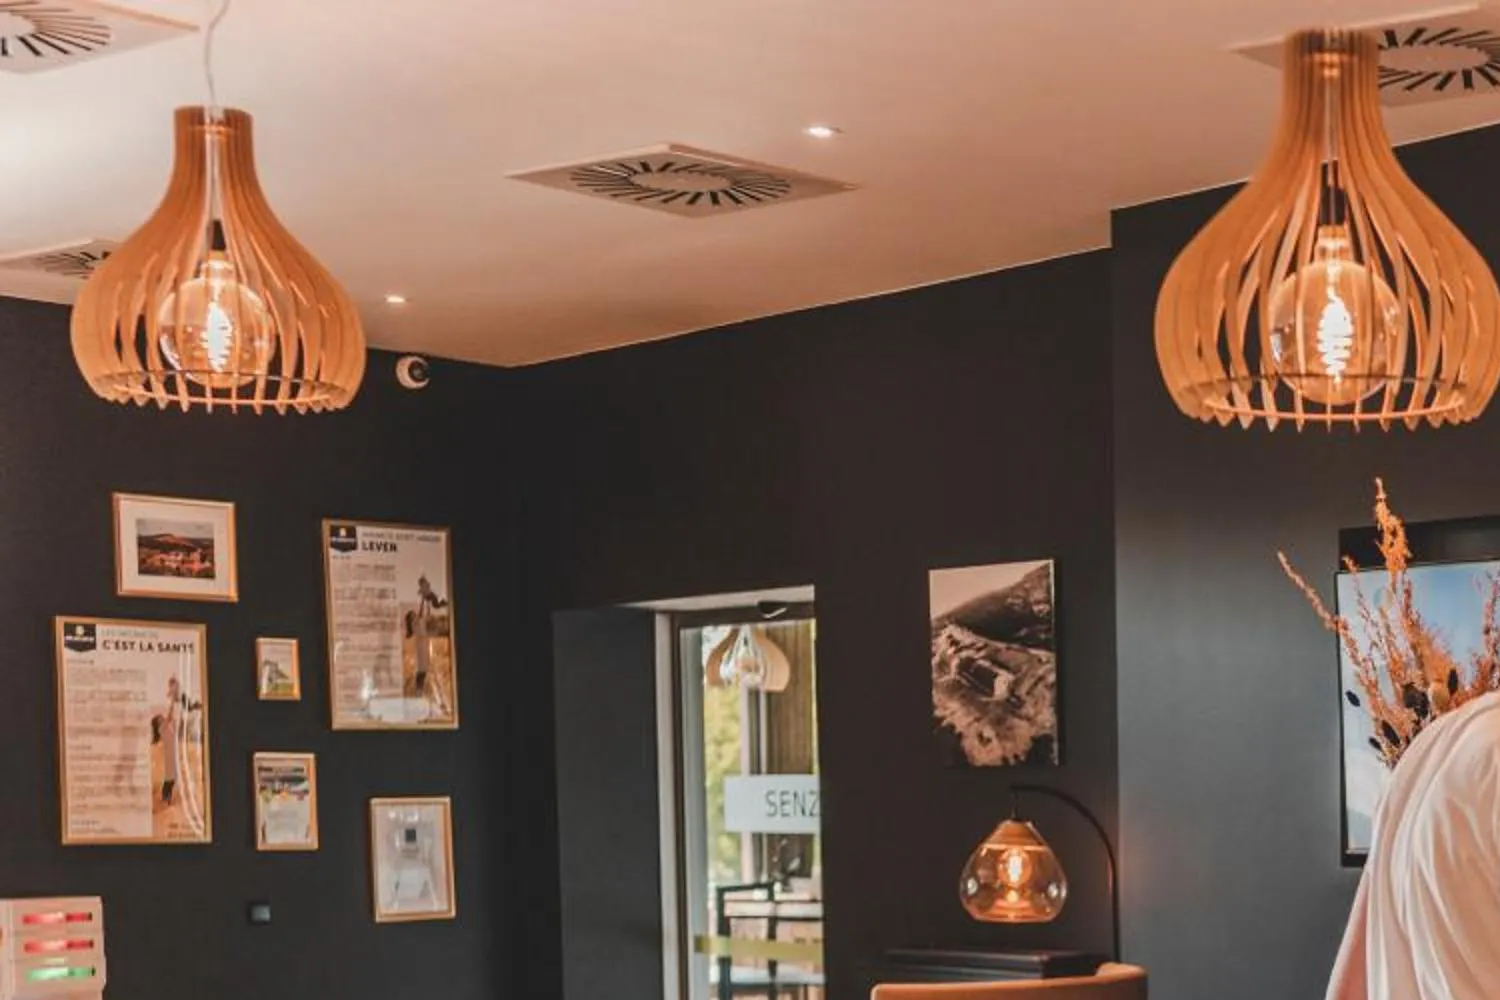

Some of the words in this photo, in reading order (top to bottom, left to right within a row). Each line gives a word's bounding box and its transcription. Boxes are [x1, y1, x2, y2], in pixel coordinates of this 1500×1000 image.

[361, 540, 398, 553] LEVEN
[102, 638, 136, 652] C'EST
[139, 640, 154, 652] LA
